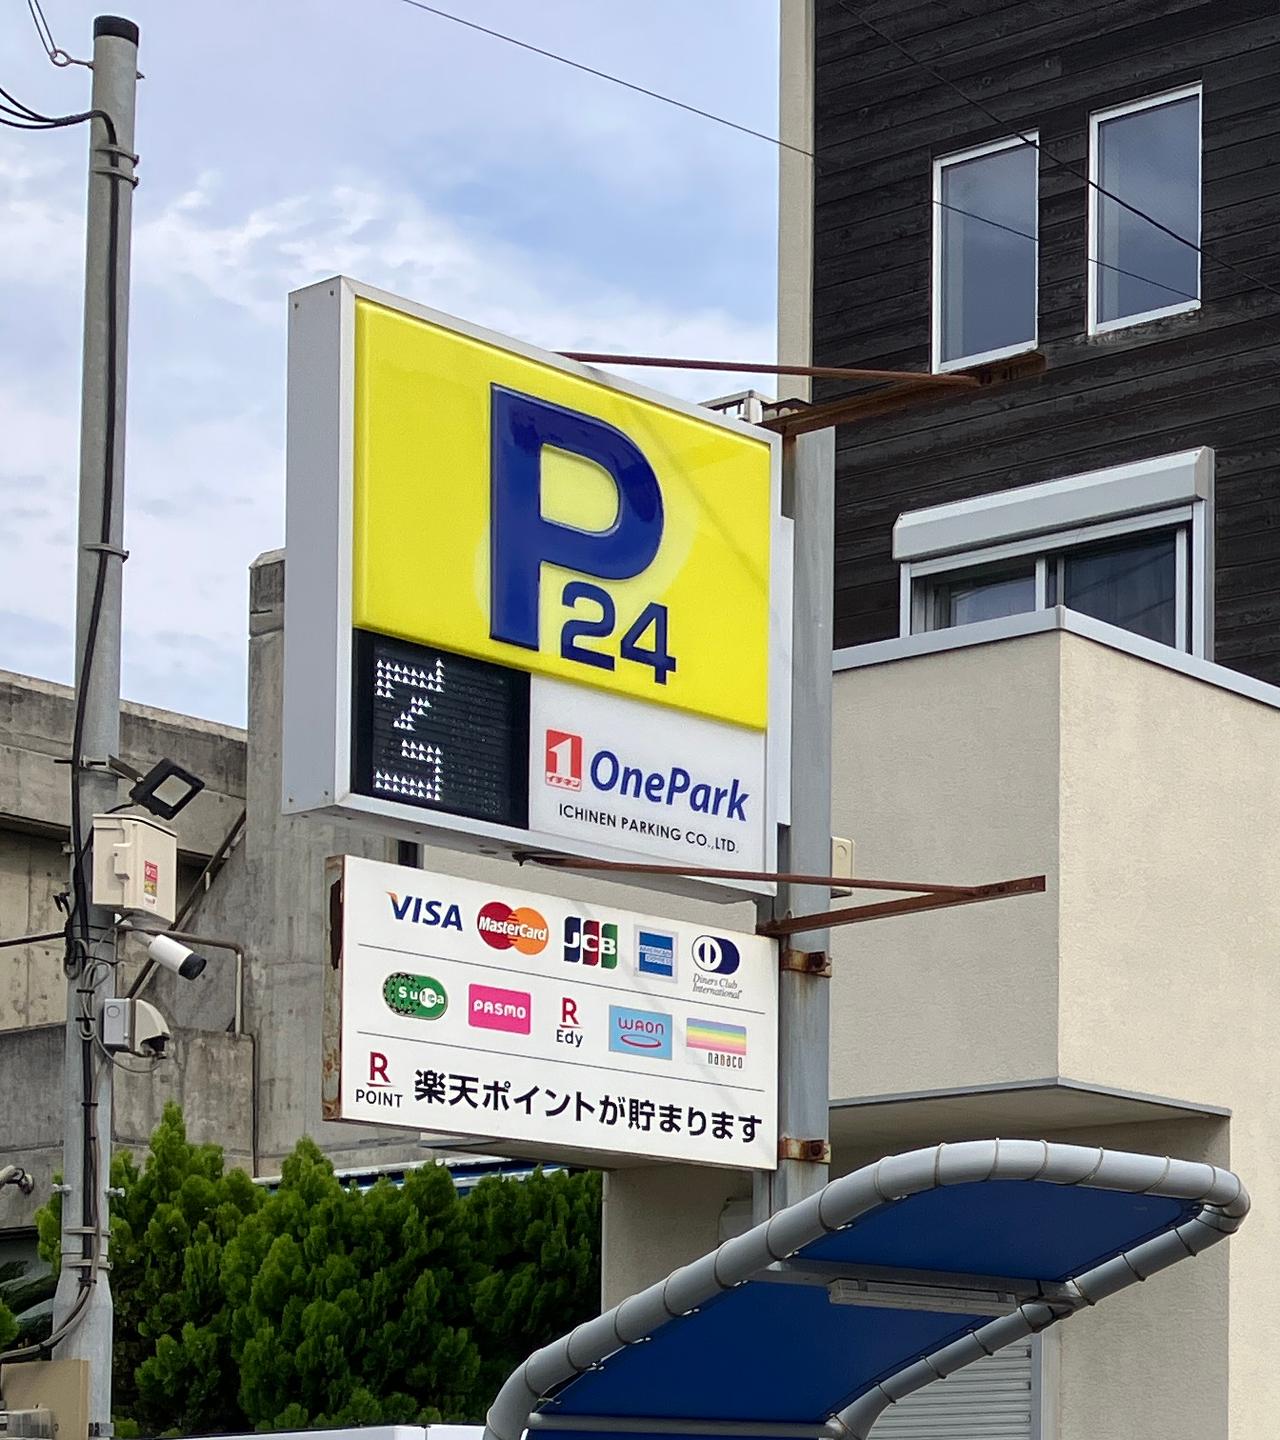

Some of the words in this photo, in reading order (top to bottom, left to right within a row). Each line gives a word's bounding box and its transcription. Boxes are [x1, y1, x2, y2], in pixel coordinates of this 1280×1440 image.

[489, 381, 664, 651] P
[560, 580, 676, 684] 24
[590, 750, 750, 822] OnePark
[559, 803, 616, 828] ICHINEN
[621, 817, 681, 841] PARKING
[386, 891, 463, 932] VISA
[478, 915, 548, 941] MasterCard
[692, 982, 740, 999] International
[693, 973, 718, 986] Diners
[719, 978, 738, 989] Club
[398, 983, 445, 1006] Suica
[473, 999, 527, 1020] PASMO
[618, 1016, 664, 1036] WAON
[555, 1029, 583, 1048] Edy
[707, 1052, 743, 1070] nanaco
[356, 1089, 403, 1108] POINT
[414, 1068, 762, 1143] 楽天ポイントが貯まります
